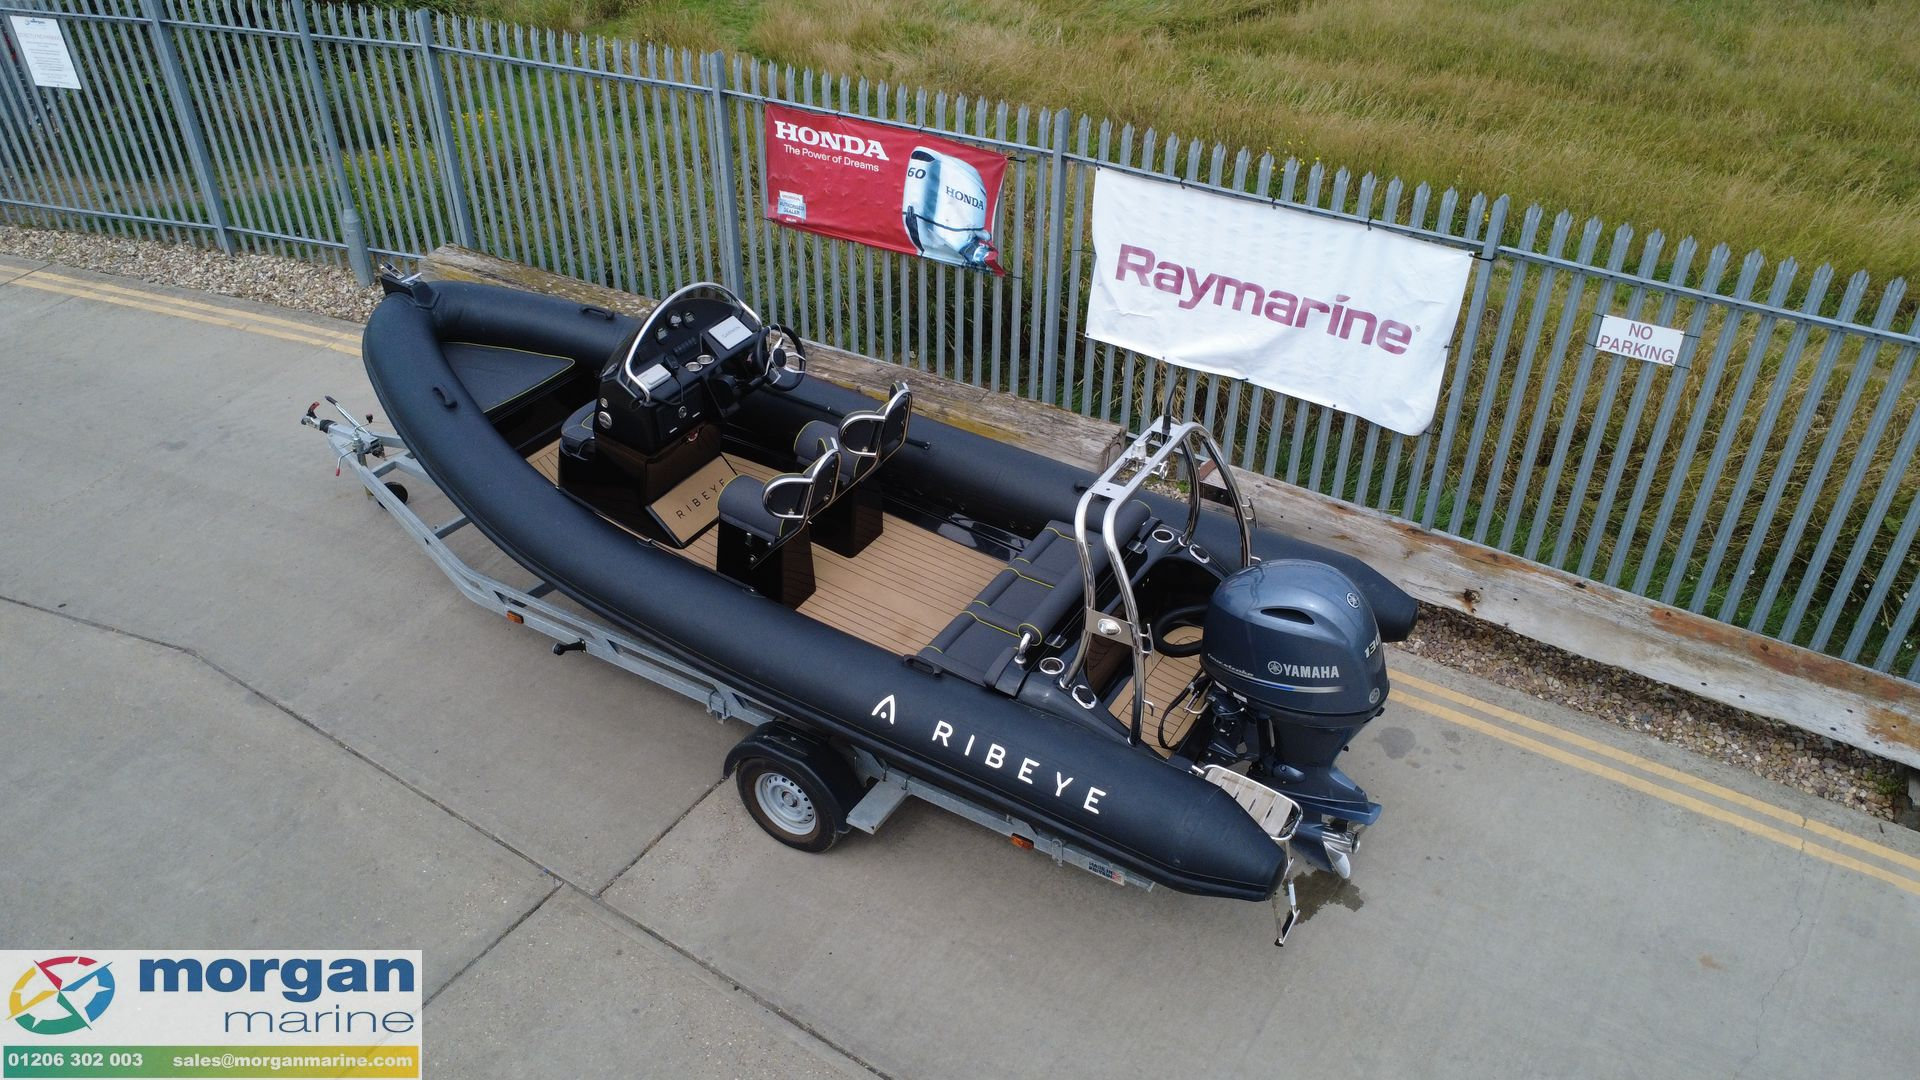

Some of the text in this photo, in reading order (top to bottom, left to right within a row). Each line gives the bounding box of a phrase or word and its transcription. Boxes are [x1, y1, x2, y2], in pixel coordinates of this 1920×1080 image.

[775, 120, 889, 160] HONDA
[784, 144, 879, 172] The Power of Dreams
[907, 167, 926, 179] 60
[946, 186, 984, 210] HONDA
[1115, 243, 1411, 355] Raymarine
[1628, 323, 1653, 340] NO
[1600, 335, 1675, 363] PARKING
[1283, 663, 1340, 679] YAMAHA
[932, 720, 1106, 814] RIBEYE
